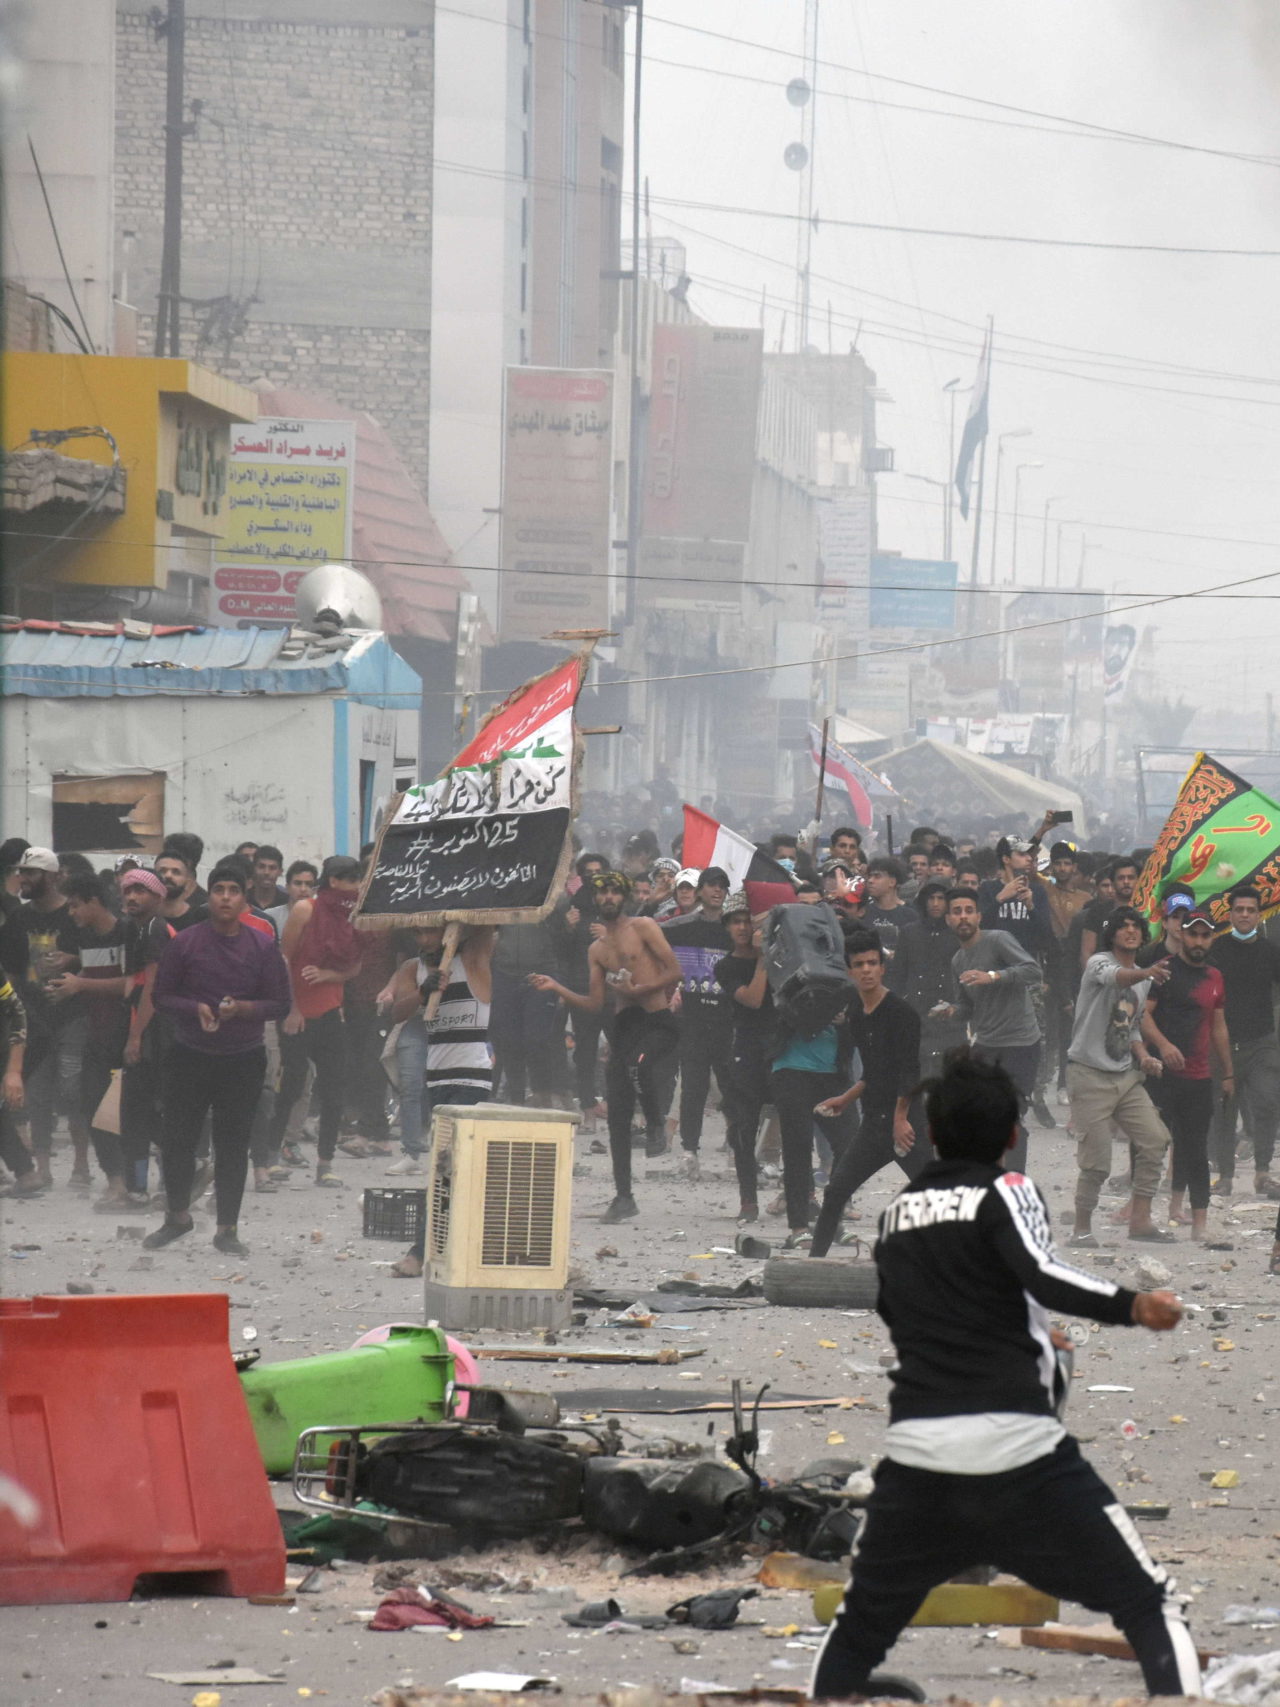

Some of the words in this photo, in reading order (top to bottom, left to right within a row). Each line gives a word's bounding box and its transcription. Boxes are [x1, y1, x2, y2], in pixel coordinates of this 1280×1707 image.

[266, 421, 304, 435] الدكتور
[508, 409, 545, 438] المهدي
[547, 413, 571, 437] عبد
[574, 410, 611, 440] ميثاق
[276, 439, 311, 458] مراد
[315, 442, 346, 461] فريد
[258, 469, 269, 488] في
[301, 494, 340, 512] الباطنية
[246, 518, 293, 536] السكري
